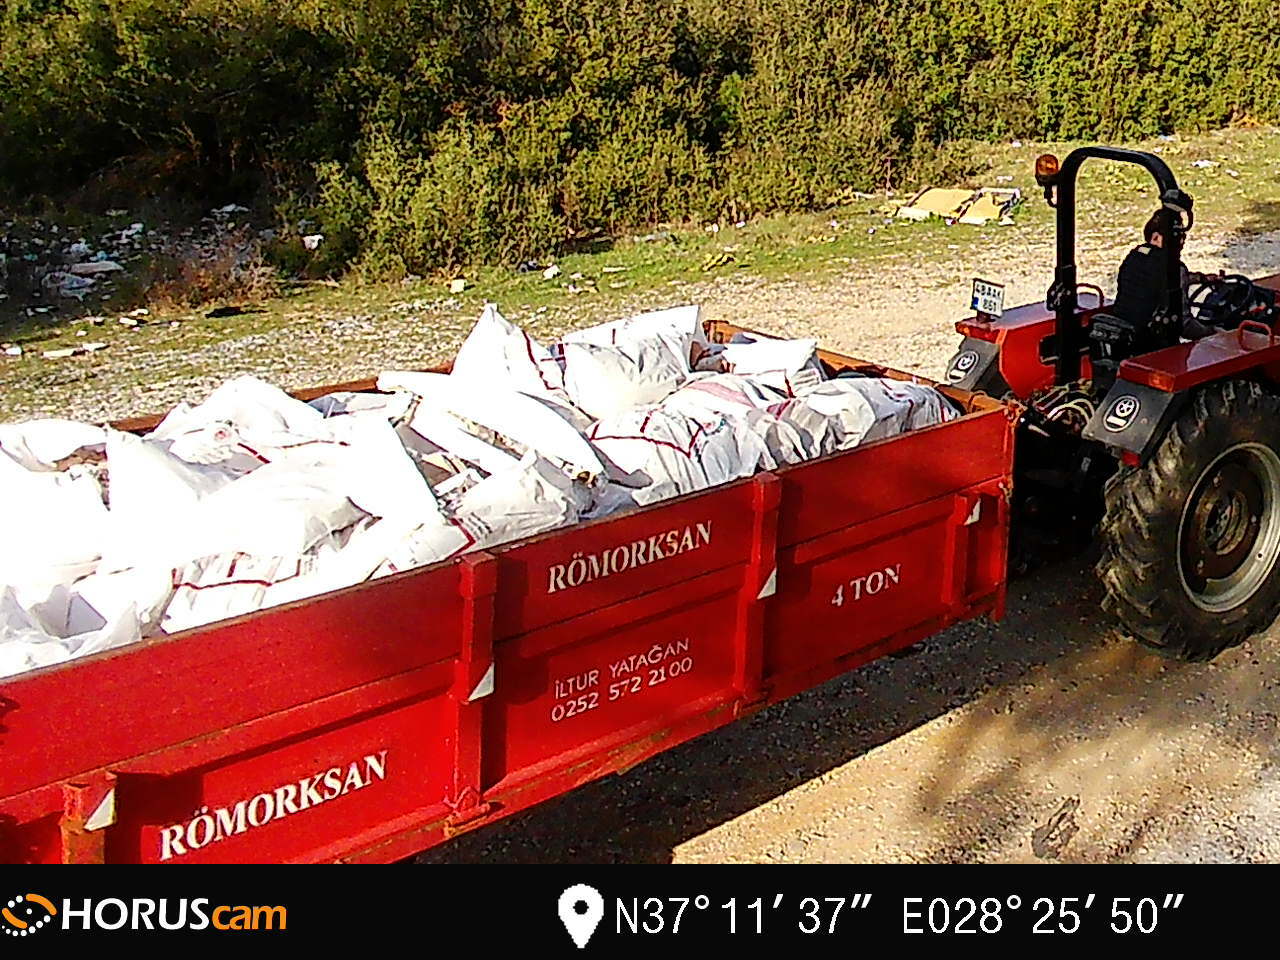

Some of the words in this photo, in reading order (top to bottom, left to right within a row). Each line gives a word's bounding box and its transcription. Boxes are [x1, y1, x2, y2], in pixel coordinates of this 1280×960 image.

[547, 519, 712, 594] RÖMORKSAN
[831, 584, 844, 607] 4
[849, 563, 901, 600] TON
[551, 692, 600, 722] 0252
[608, 676, 642, 701] 572
[648, 656, 693, 686] 2100
[554, 669, 600, 700] İLTUR
[608, 638, 690, 679] YATAĞAN
[159, 749, 388, 862] RÖMORKSAN
